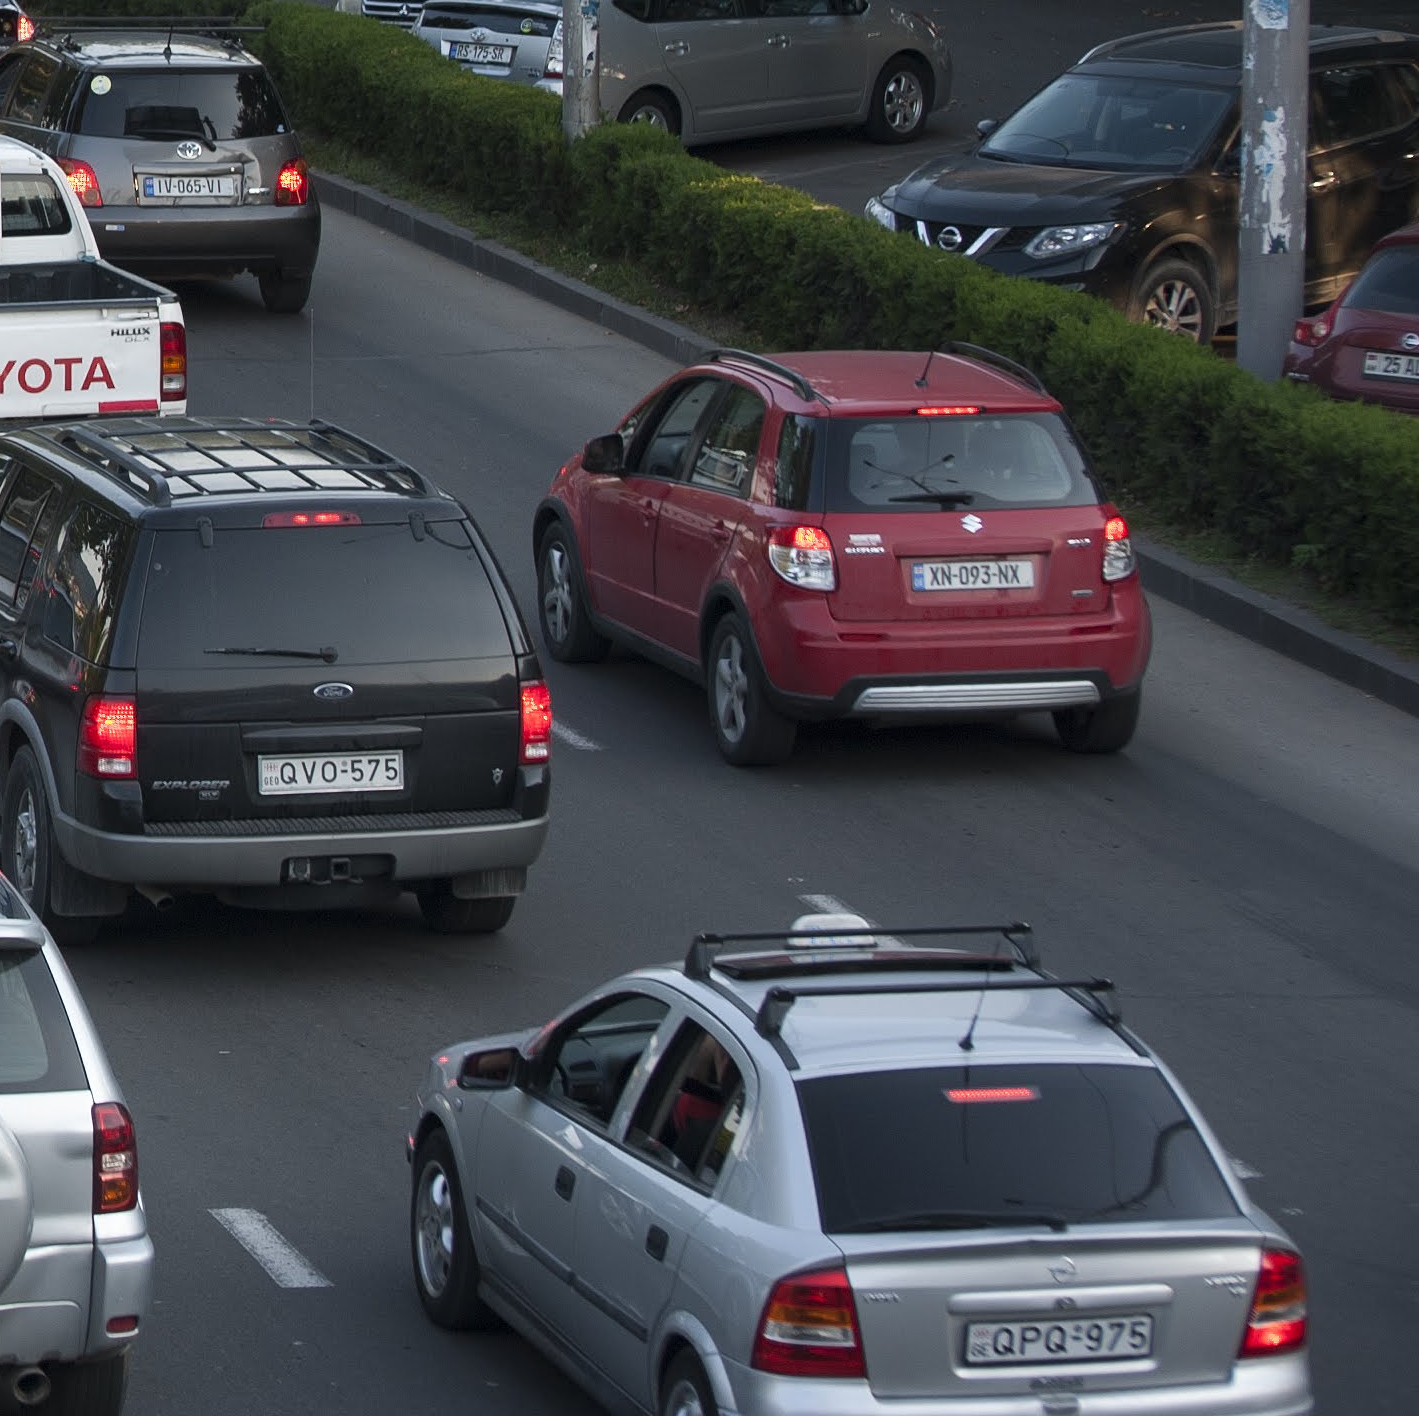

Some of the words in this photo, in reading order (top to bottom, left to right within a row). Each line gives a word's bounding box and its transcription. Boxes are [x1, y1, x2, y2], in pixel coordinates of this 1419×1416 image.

[929, 563, 1021, 587] XN-093-NX
[280, 758, 399, 785] QVO-575
[992, 1321, 1148, 1356] QPQ-975
